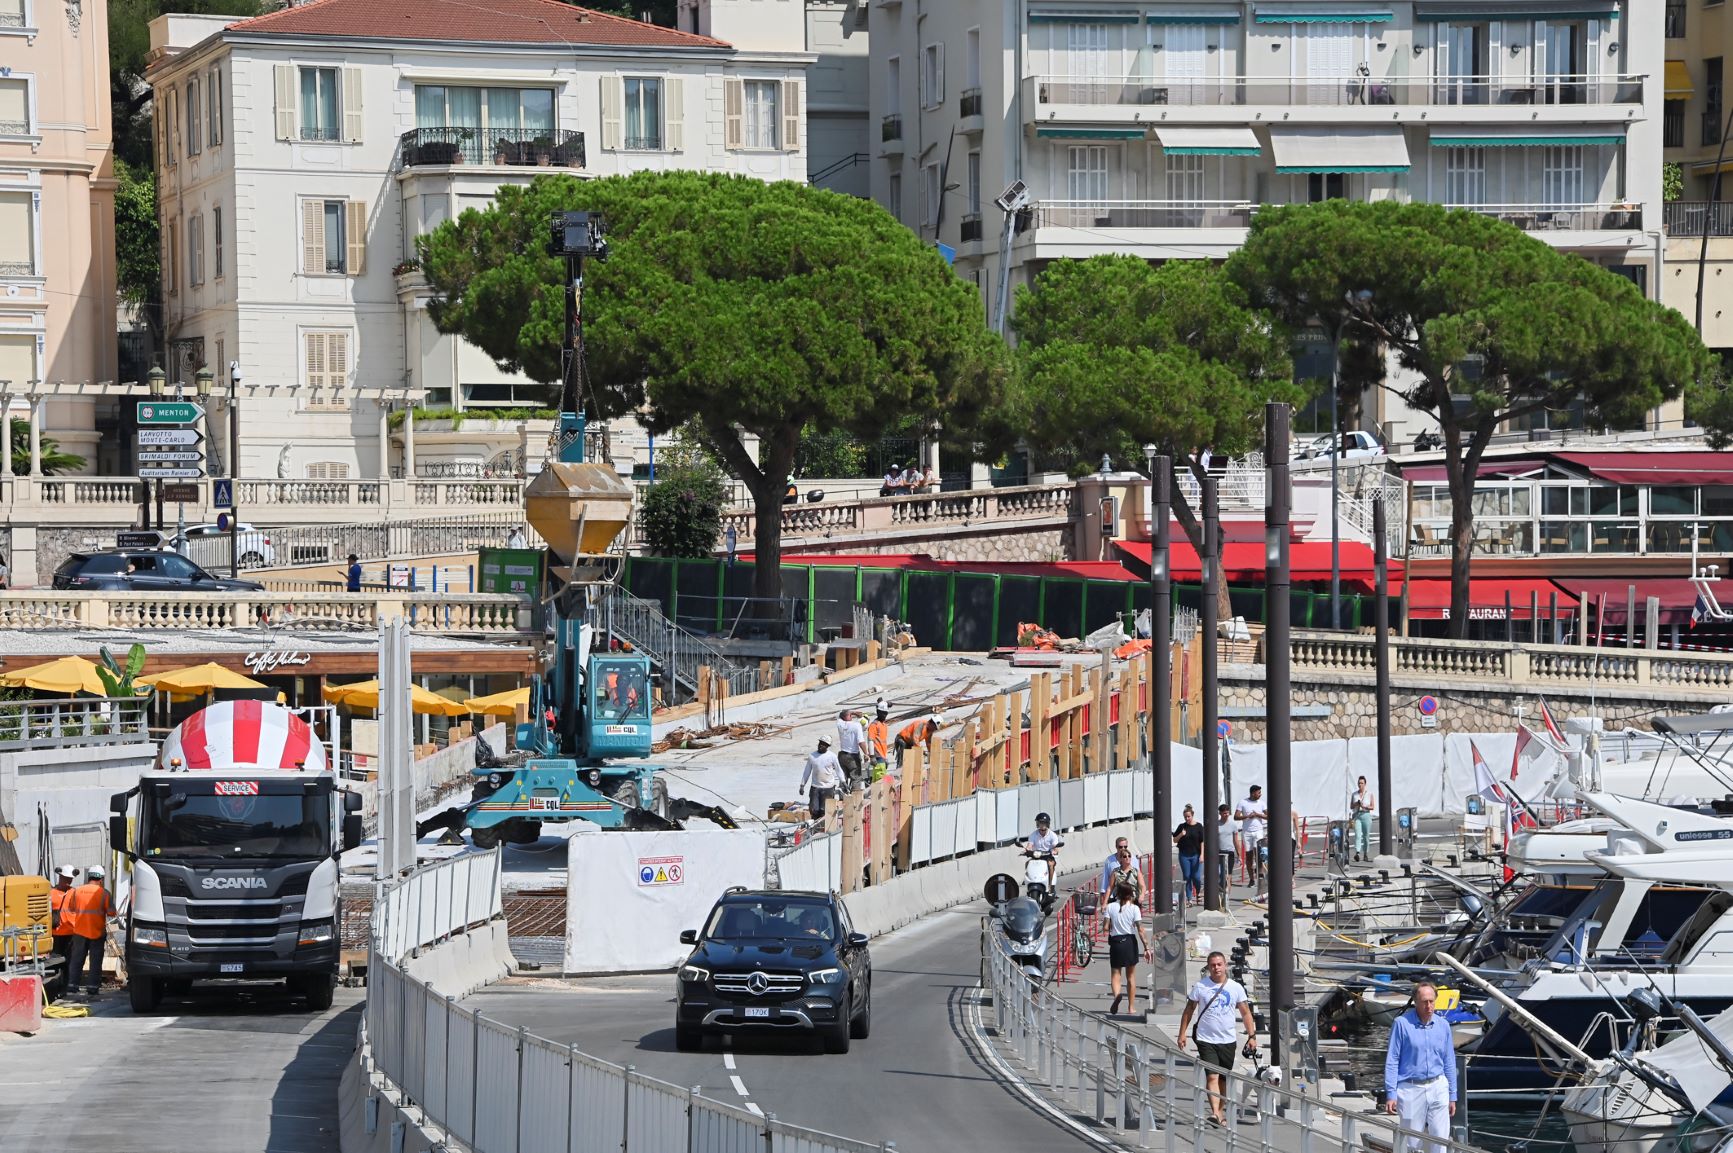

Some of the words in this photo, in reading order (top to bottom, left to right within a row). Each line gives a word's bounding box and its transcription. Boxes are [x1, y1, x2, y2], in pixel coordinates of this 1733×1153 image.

[1442, 608, 1514, 619] RAURAN
[267, 650, 311, 671] Milano
[599, 735, 648, 746] MANITOU
[223, 784, 250, 792] SERVICE
[201, 877, 268, 889] SCANIA
